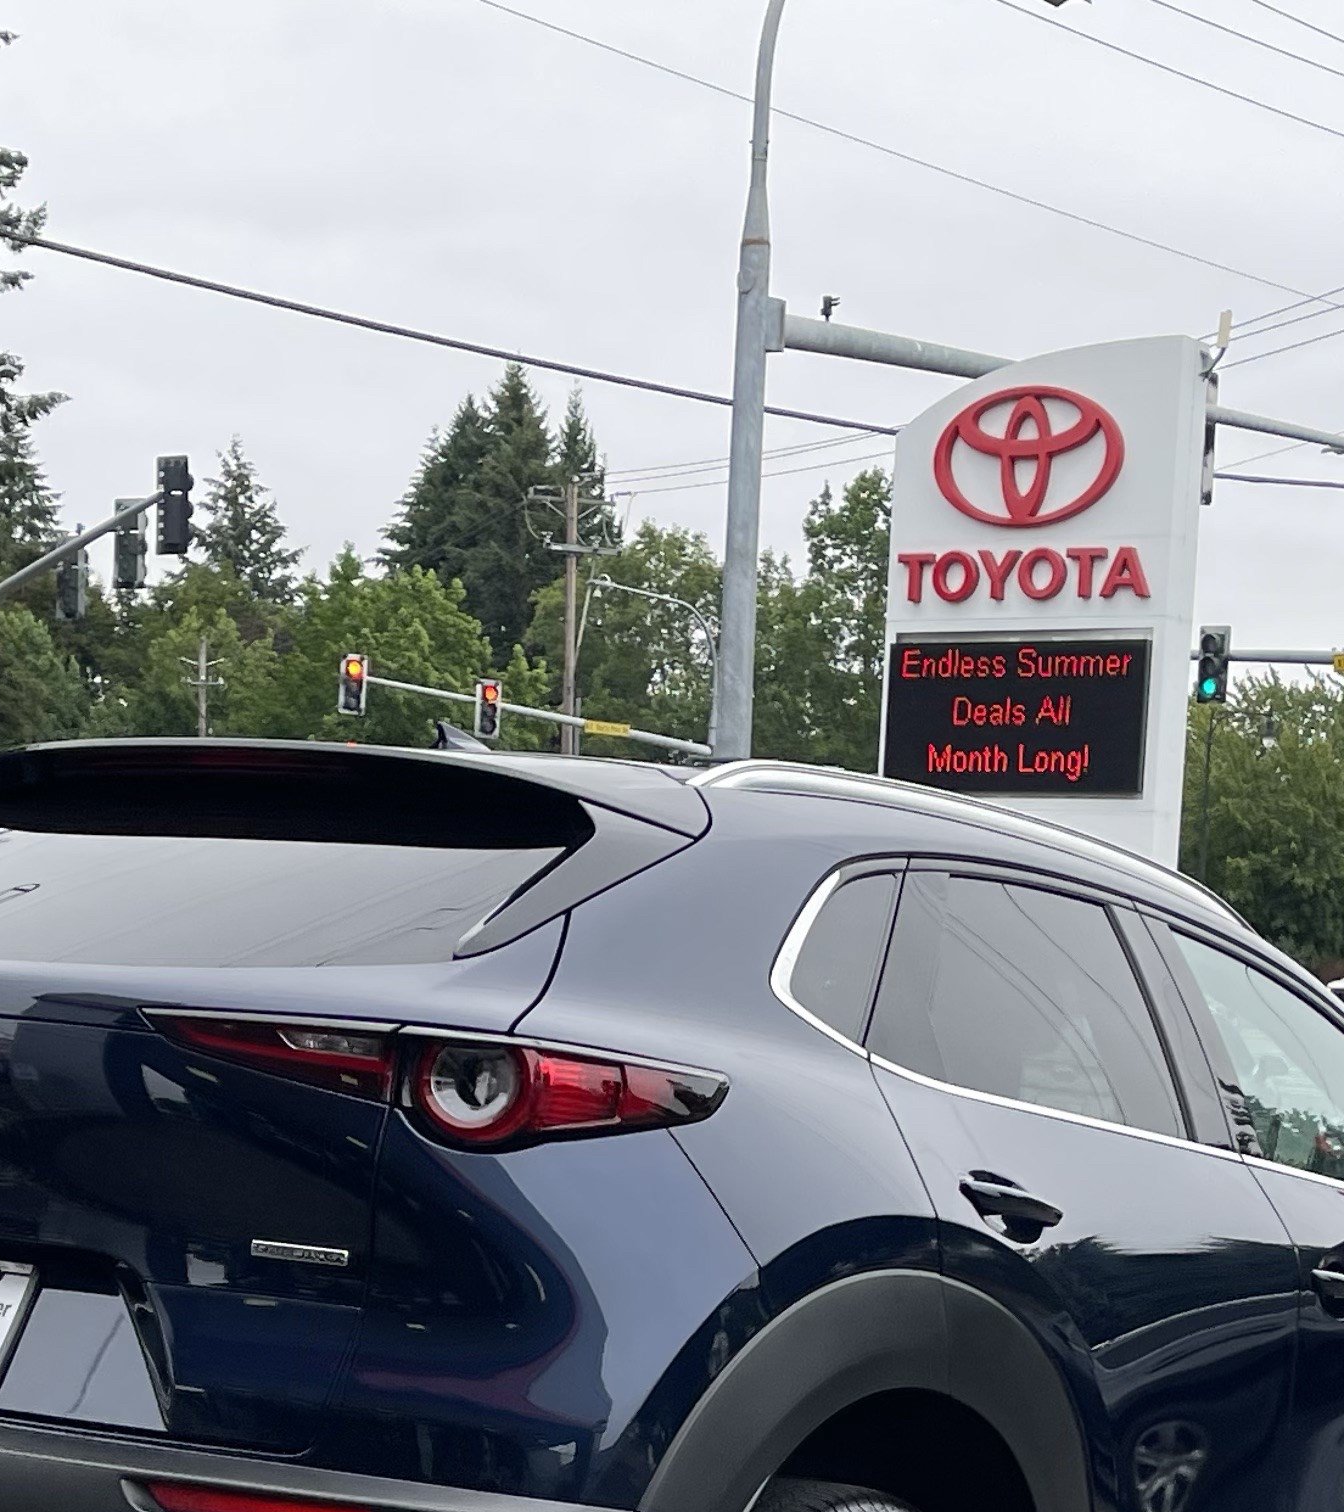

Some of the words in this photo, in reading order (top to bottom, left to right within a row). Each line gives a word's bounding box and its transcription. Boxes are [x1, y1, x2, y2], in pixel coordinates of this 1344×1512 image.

[898, 546, 1151, 603] TOYOTA
[901, 648, 1007, 679] Endless
[1017, 647, 1133, 679] Summer
[951, 695, 1026, 727] Deals
[1035, 695, 1072, 727] All
[927, 742, 1009, 774] Month
[1017, 742, 1090, 781] Long!
